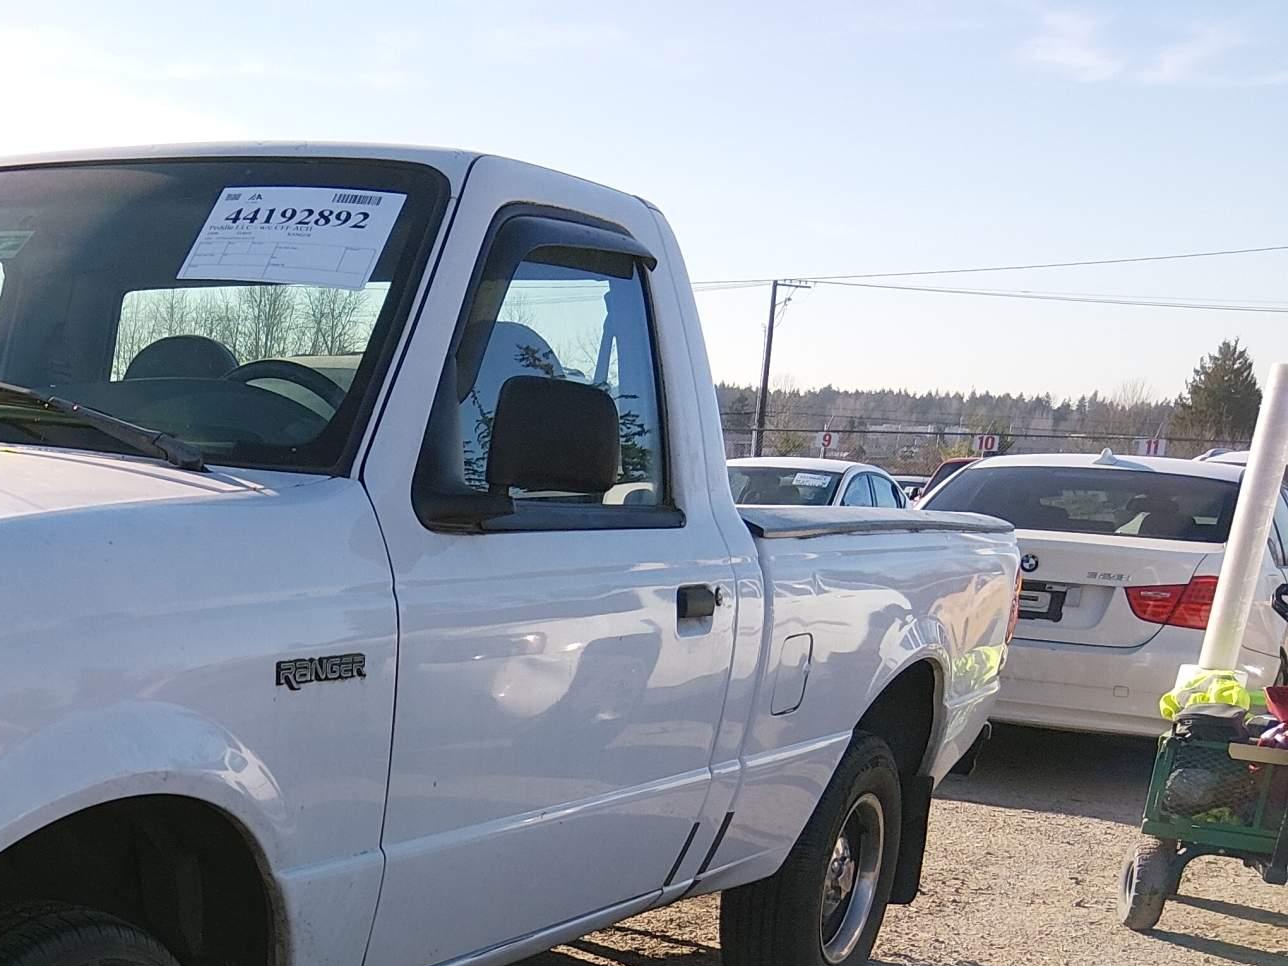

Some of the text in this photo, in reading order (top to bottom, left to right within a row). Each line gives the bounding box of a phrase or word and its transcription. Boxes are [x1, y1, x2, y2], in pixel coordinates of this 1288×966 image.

[225, 207, 370, 230] 44192892
[822, 433, 832, 448] 9
[978, 435, 995, 450] 10
[1145, 439, 1159, 455] 11
[275, 653, 366, 691] RANGER
